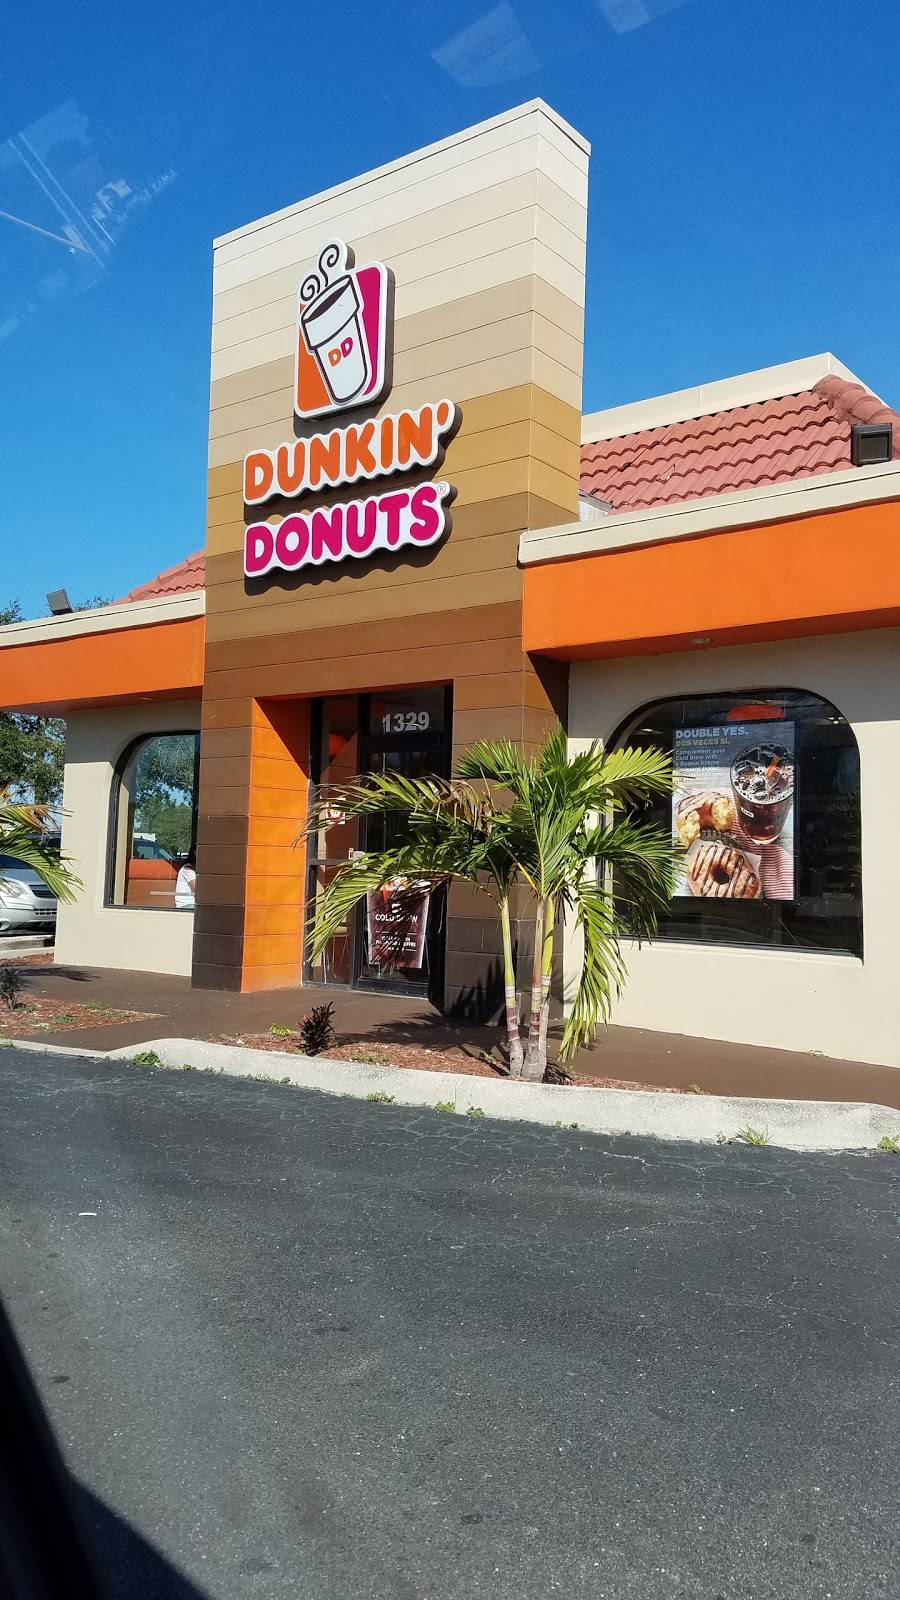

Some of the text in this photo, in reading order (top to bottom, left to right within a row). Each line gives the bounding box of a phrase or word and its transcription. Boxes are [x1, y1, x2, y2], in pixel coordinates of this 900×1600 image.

[244, 401, 449, 501] DUNKIN'
[382, 711, 430, 734] 1329
[676, 726, 749, 739] DOUBLE YES.
